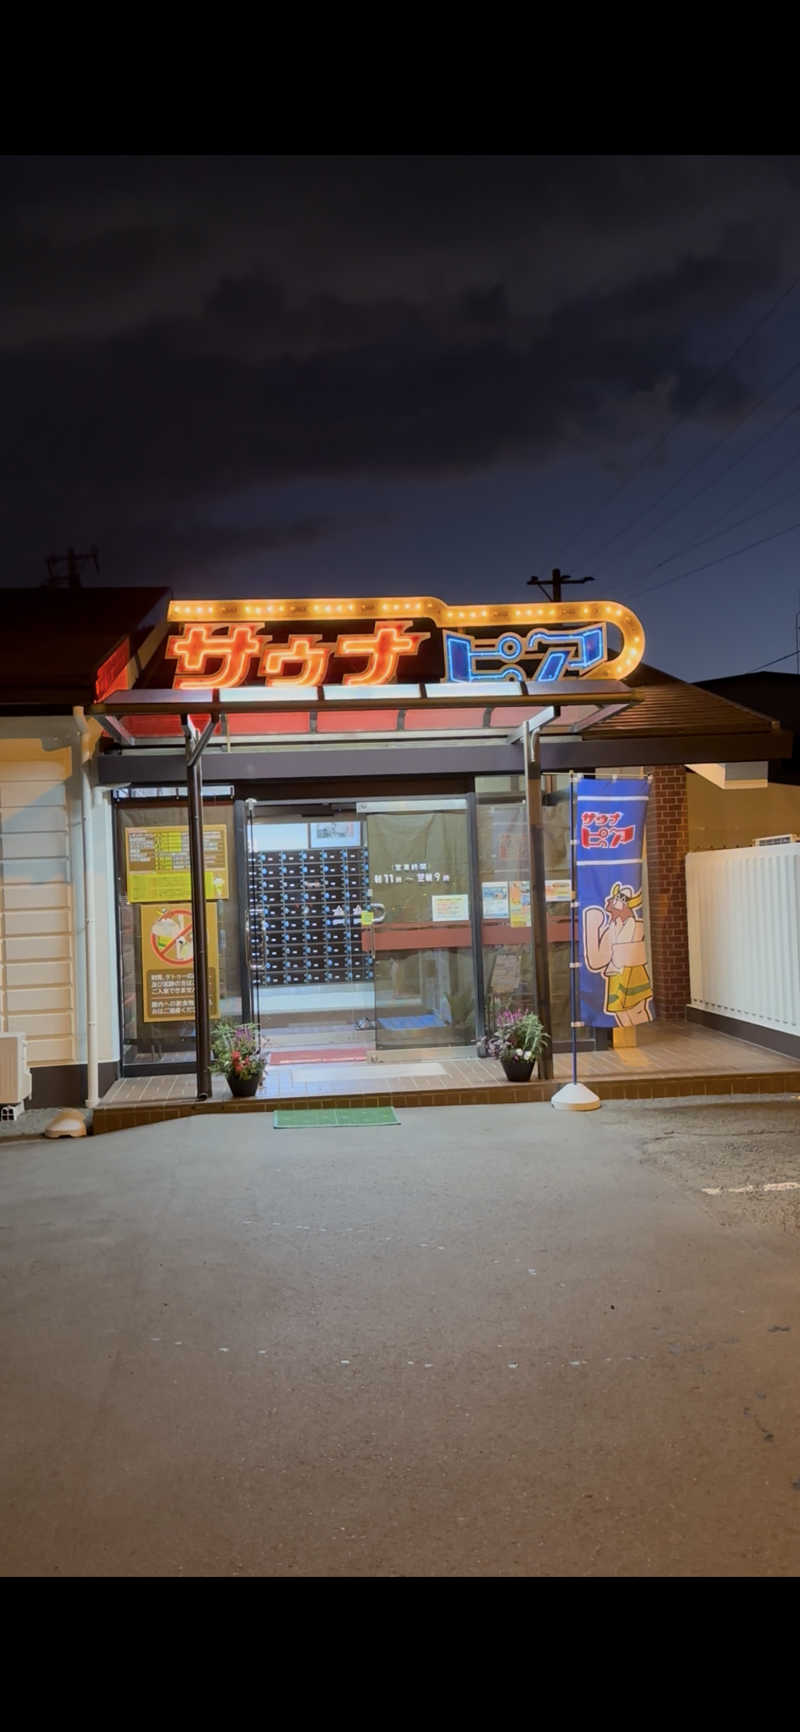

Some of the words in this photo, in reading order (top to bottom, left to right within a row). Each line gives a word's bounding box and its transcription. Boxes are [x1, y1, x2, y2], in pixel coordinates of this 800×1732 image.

[164, 620, 432, 689] サウナ
[442, 622, 608, 683] ピア
[581, 811, 624, 826] サウナ
[581, 825, 636, 849] ピア
